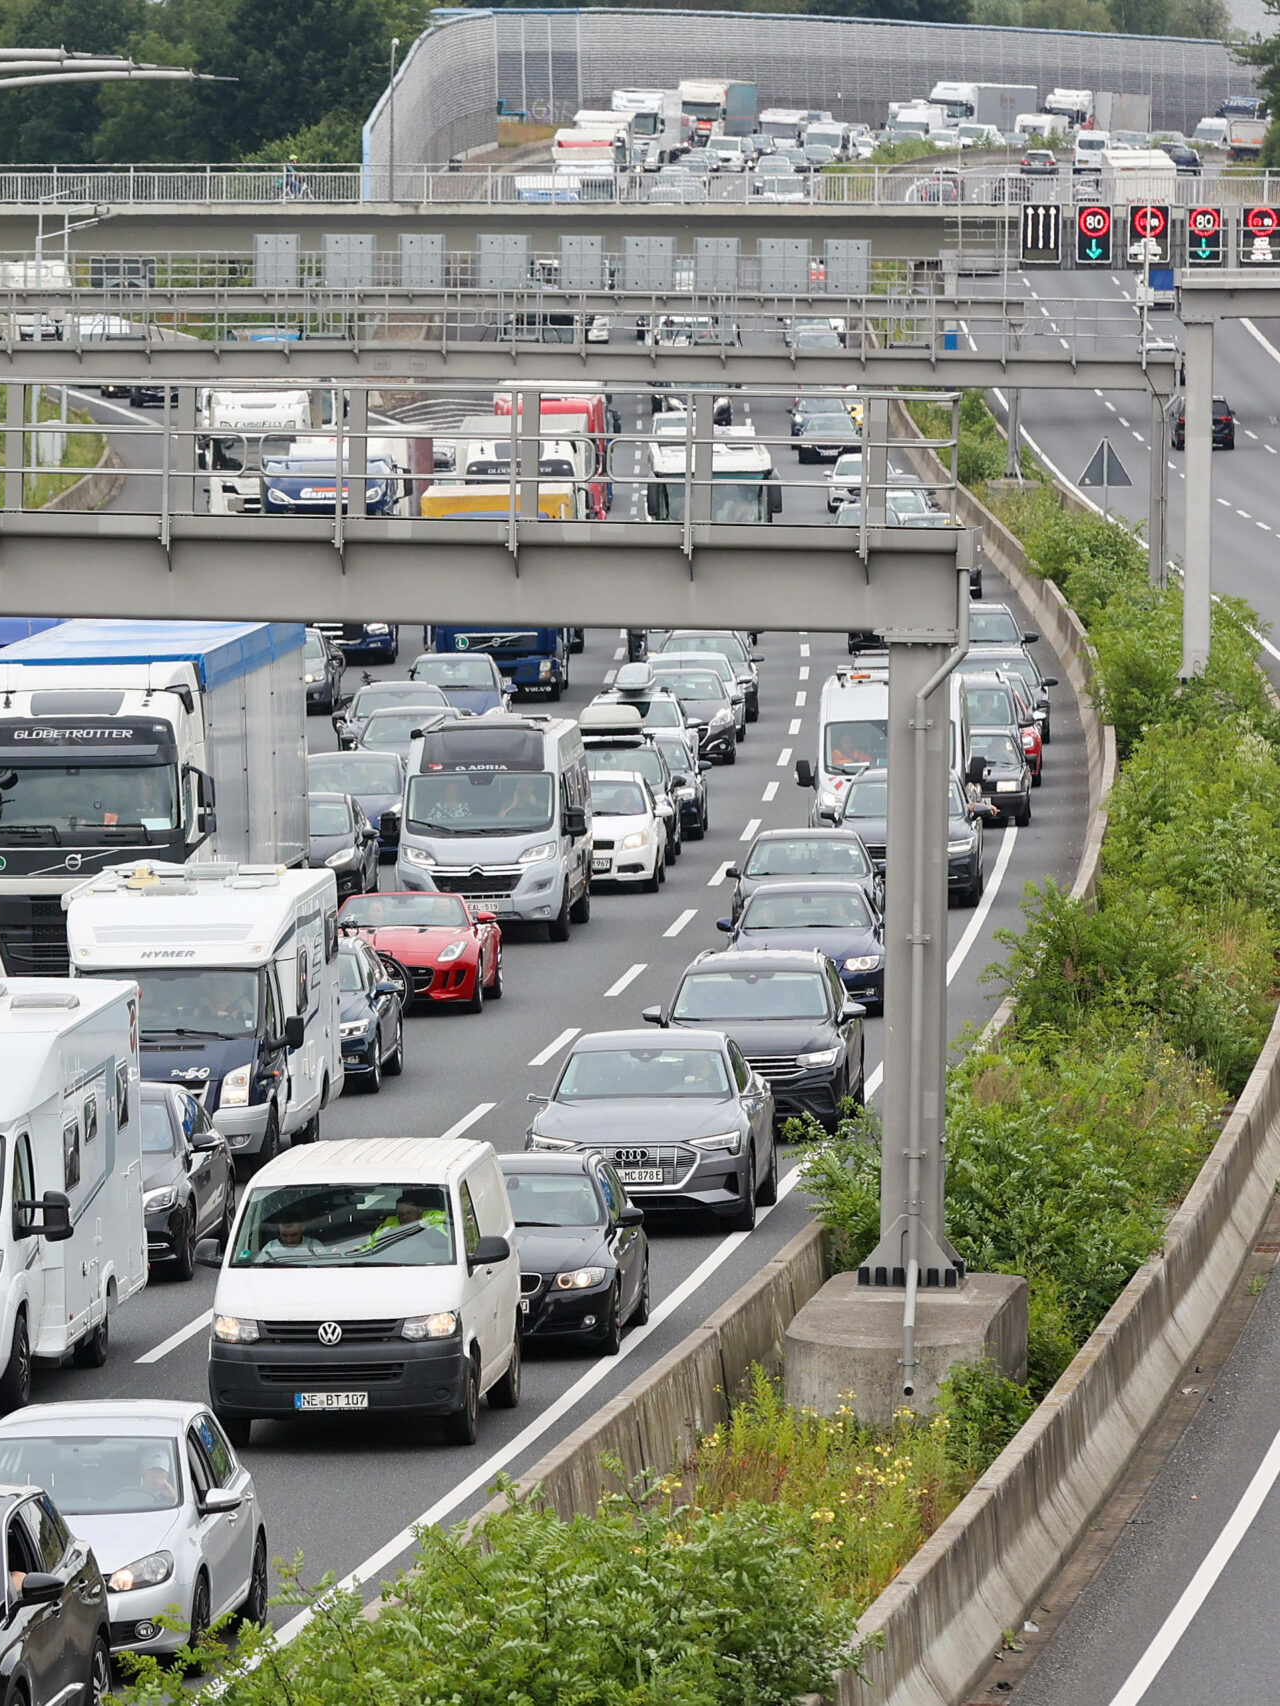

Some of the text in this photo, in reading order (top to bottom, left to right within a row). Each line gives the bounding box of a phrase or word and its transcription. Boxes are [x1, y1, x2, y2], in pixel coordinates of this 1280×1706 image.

[1085, 215, 1104, 229] 80
[1196, 214, 1214, 229] 80
[458, 638, 465, 648] L
[13, 727, 134, 740] GLOBETROTTER
[140, 950, 197, 959] HYMER
[624, 1170, 662, 1181] MC 878 E
[302, 1394, 366, 1407] NE BT 107
